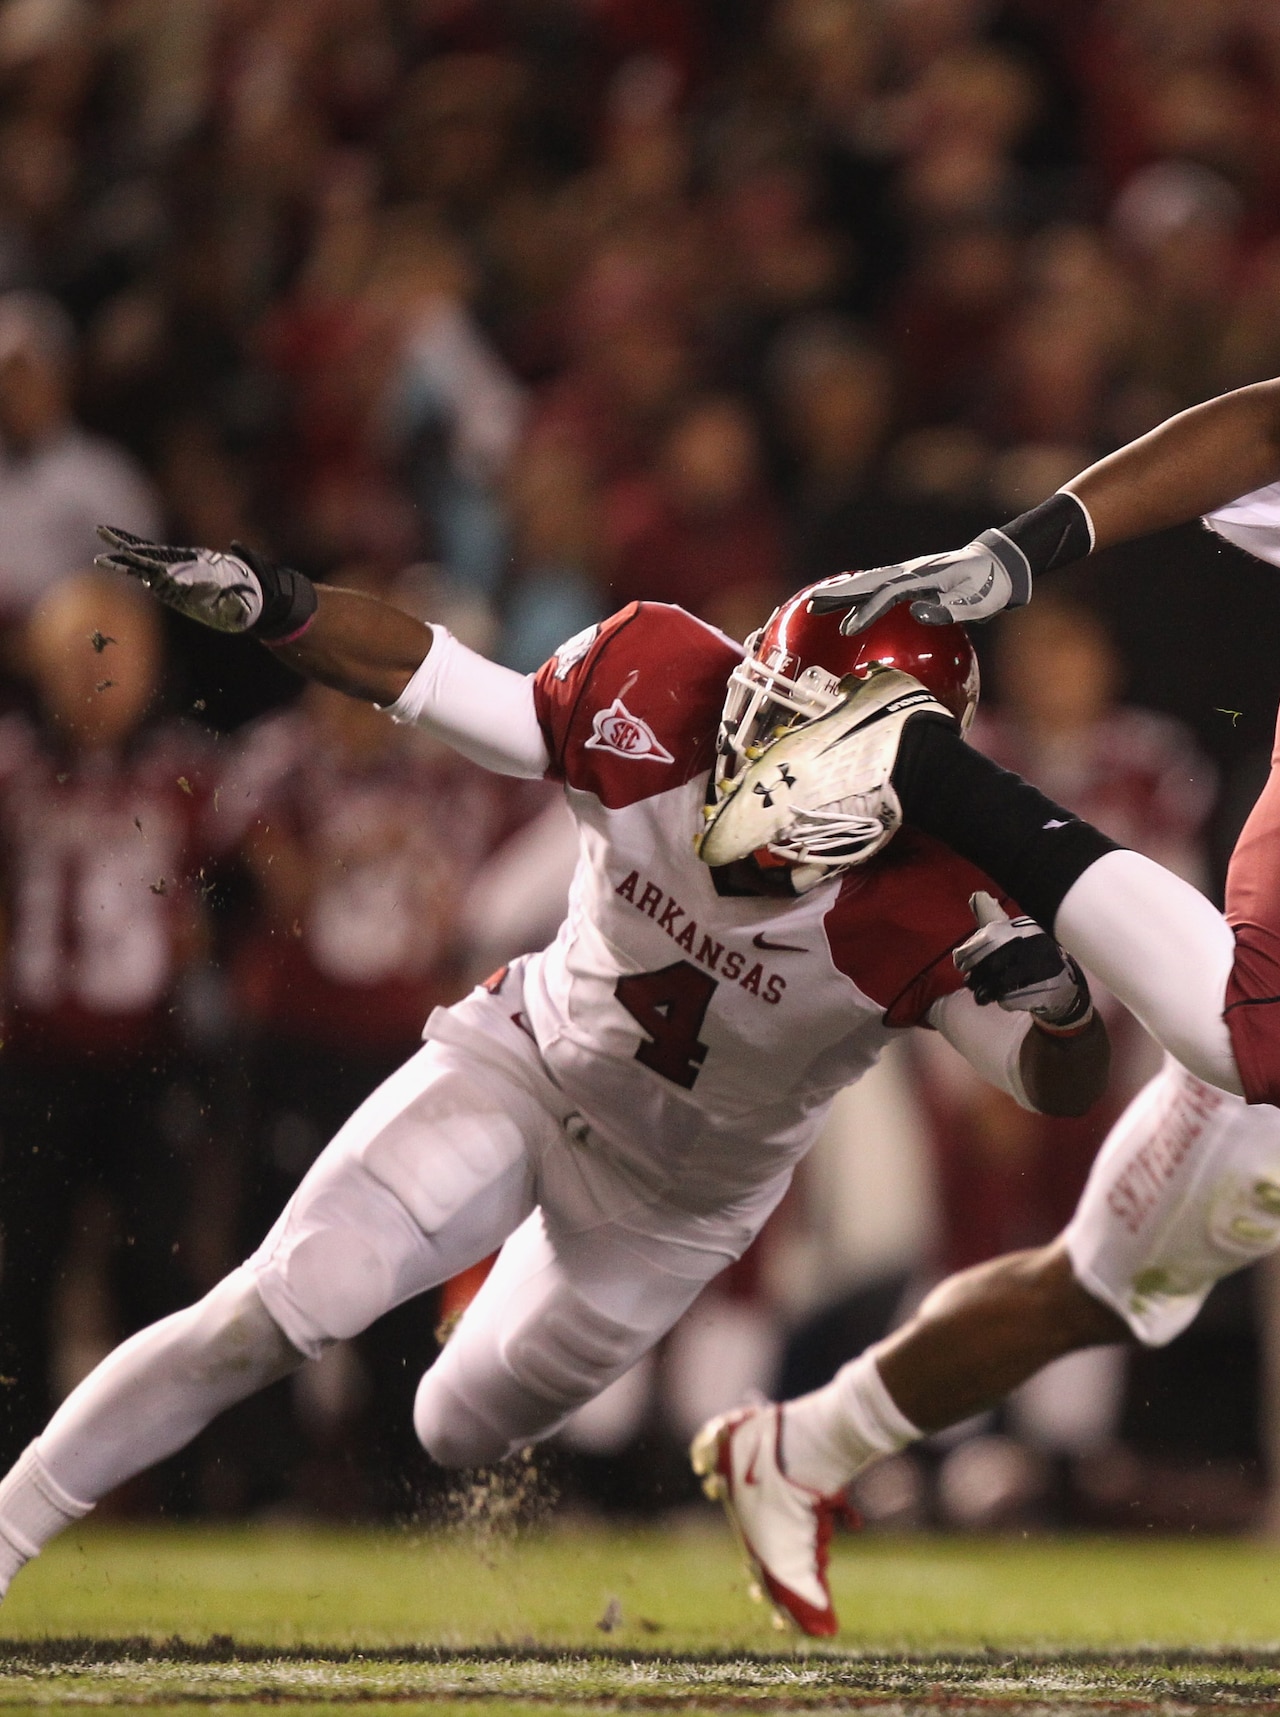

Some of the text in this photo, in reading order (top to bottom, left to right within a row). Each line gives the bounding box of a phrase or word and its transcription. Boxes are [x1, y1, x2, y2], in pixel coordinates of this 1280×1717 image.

[610, 721, 641, 750] SEC
[615, 870, 787, 1005] ARKANSAS
[614, 959, 719, 1091] 4
